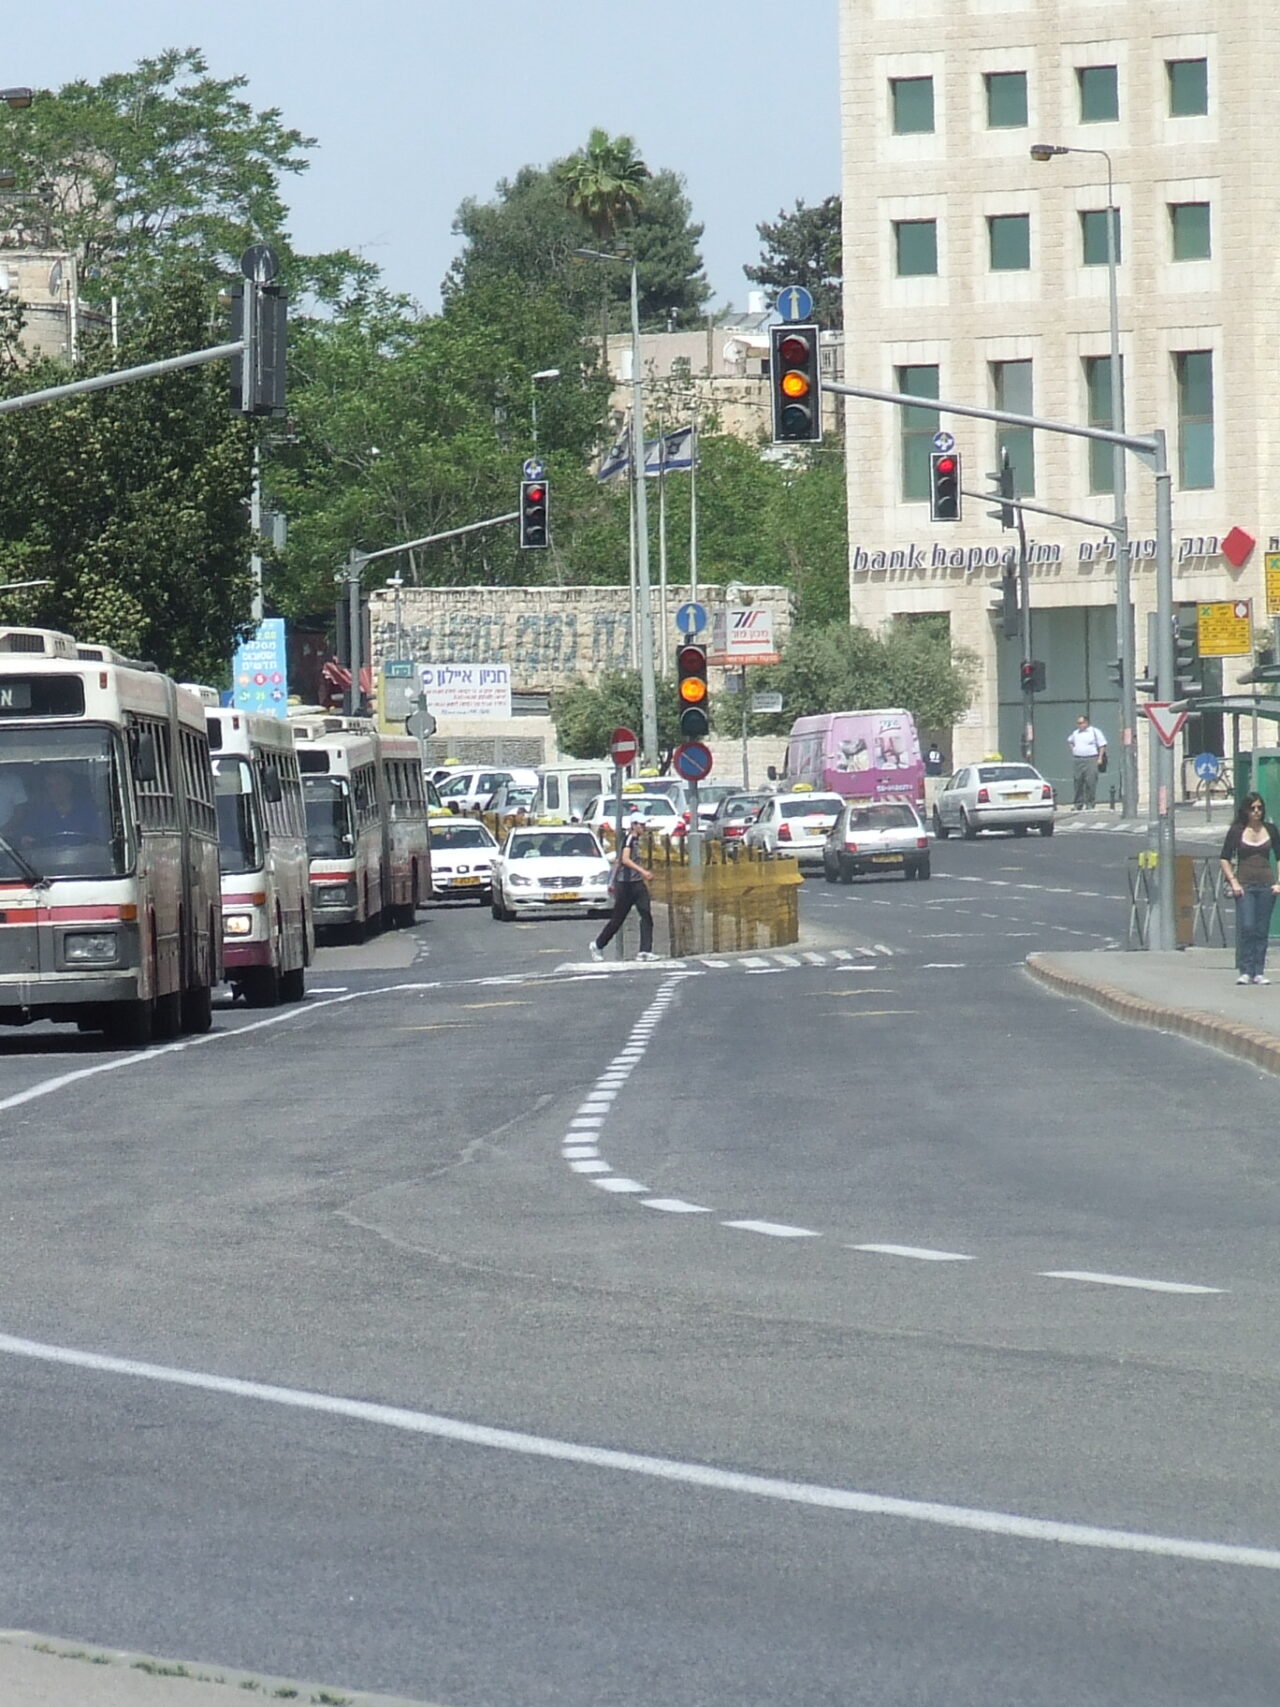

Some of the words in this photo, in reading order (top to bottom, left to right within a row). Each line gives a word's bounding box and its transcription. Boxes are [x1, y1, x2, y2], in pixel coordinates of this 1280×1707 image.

[853, 543, 926, 571] bank
[930, 541, 1061, 573] hapoaim
[1177, 535, 1218, 563] בנק
[437, 666, 473, 687] איילון
[479, 669, 508, 686] חניון
